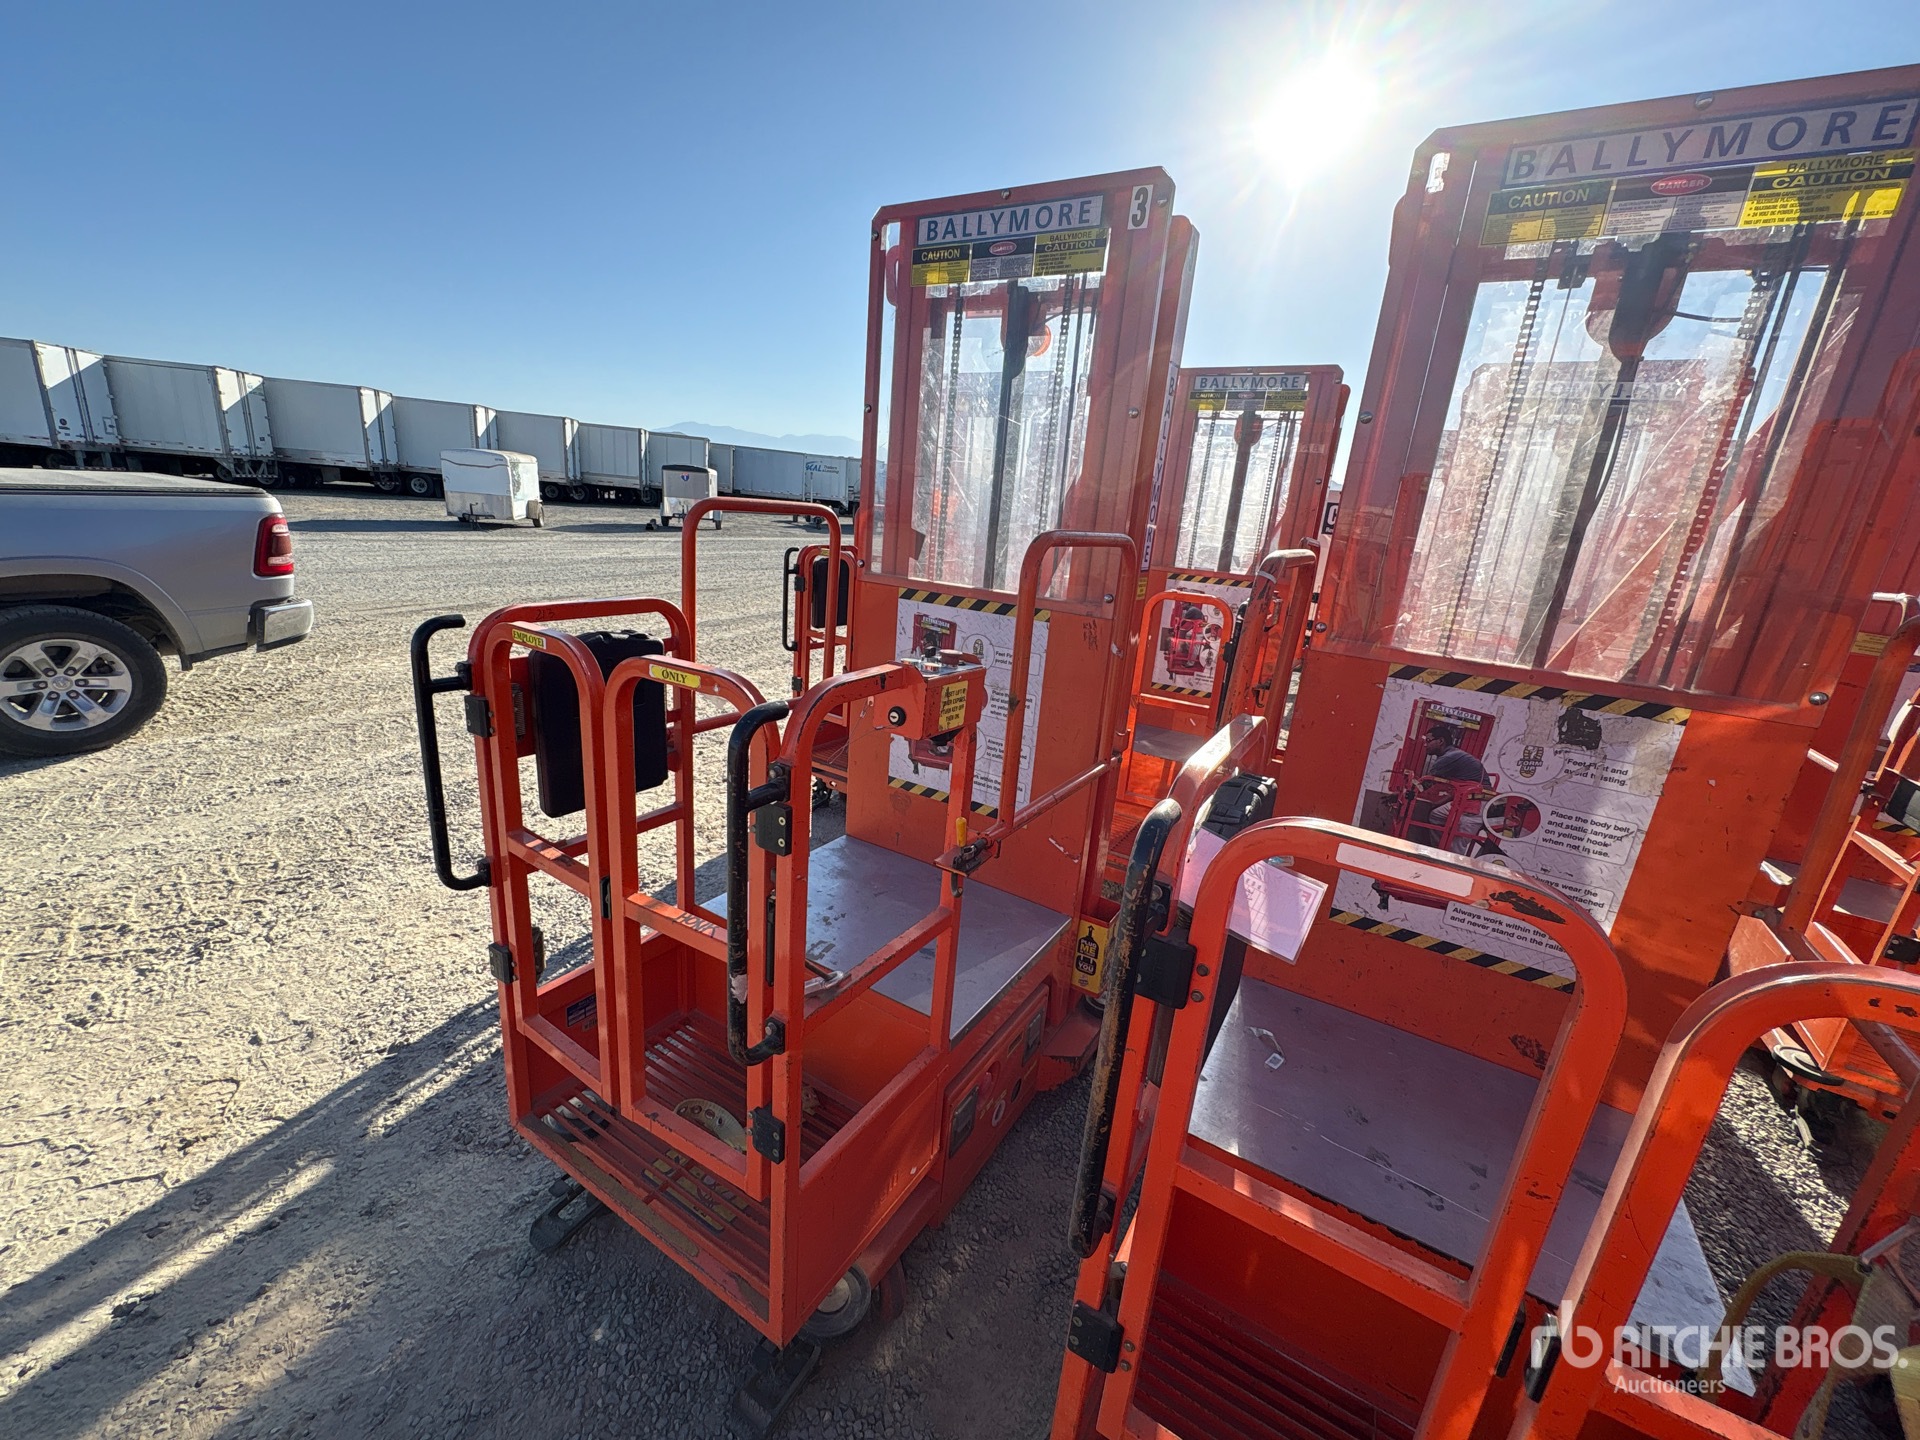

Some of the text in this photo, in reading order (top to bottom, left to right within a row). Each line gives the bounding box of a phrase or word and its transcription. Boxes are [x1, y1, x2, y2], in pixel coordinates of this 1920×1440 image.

[1511, 103, 1908, 180] BALLYMORE
[1786, 154, 1885, 173] BALLYMORE
[1657, 178, 1705, 191] DANGER
[1771, 167, 1890, 189] CAUTION
[1132, 186, 1149, 228] 3
[1508, 188, 1590, 209] CAUTION
[926, 200, 1092, 242] BALLYMORE
[1049, 231, 1092, 242] BALLYMORE
[1044, 240, 1096, 252] CAUTION
[921, 249, 960, 262] CAUTION
[1200, 376, 1300, 390] BALLYMORE
[661, 668, 688, 684] ONLY
[1610, 767, 1629, 776] and
[1550, 810, 1631, 833] Place the body belt
[1547, 820, 1624, 842] and static lanyard
[1557, 831, 1585, 843] yellow
[1586, 837, 1609, 848] hook
[1542, 837, 1610, 858] when not in use.
[1561, 884, 1582, 893] wear
[1583, 889, 1598, 897] the
[1450, 915, 1466, 923] and
[1466, 920, 1490, 931] never
[1491, 926, 1515, 938] stand
[1516, 934, 1528, 942] on
[1529, 937, 1544, 946] the
[1453, 907, 1547, 938] Always work within the
[1081, 939, 1097, 948] PLUG
[1081, 944, 1096, 954] ME
[1078, 960, 1094, 972] YOU
